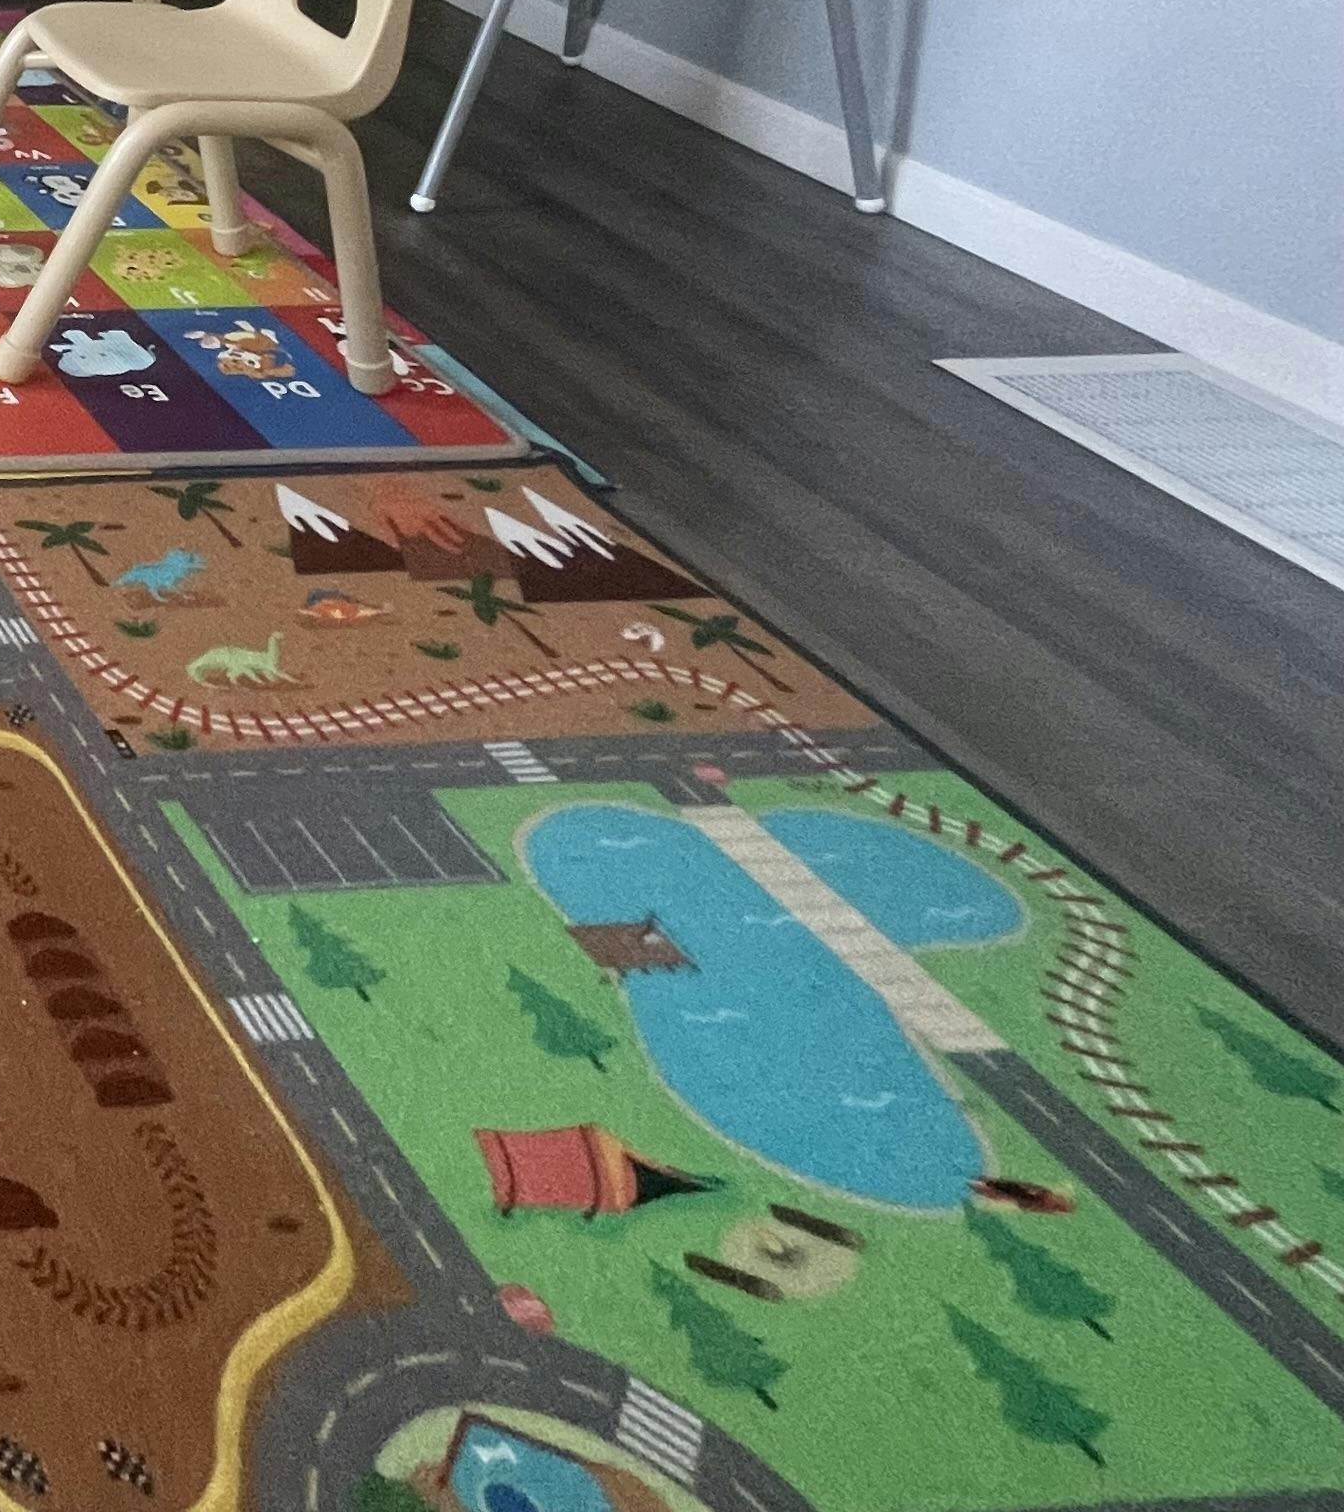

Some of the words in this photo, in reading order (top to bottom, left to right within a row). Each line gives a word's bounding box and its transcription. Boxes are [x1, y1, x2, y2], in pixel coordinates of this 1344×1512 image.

[14, 148, 51, 161] Vv
[120, 384, 168, 401] Ee
[261, 381, 321, 398] Dd
[401, 378, 454, 394] Cc
